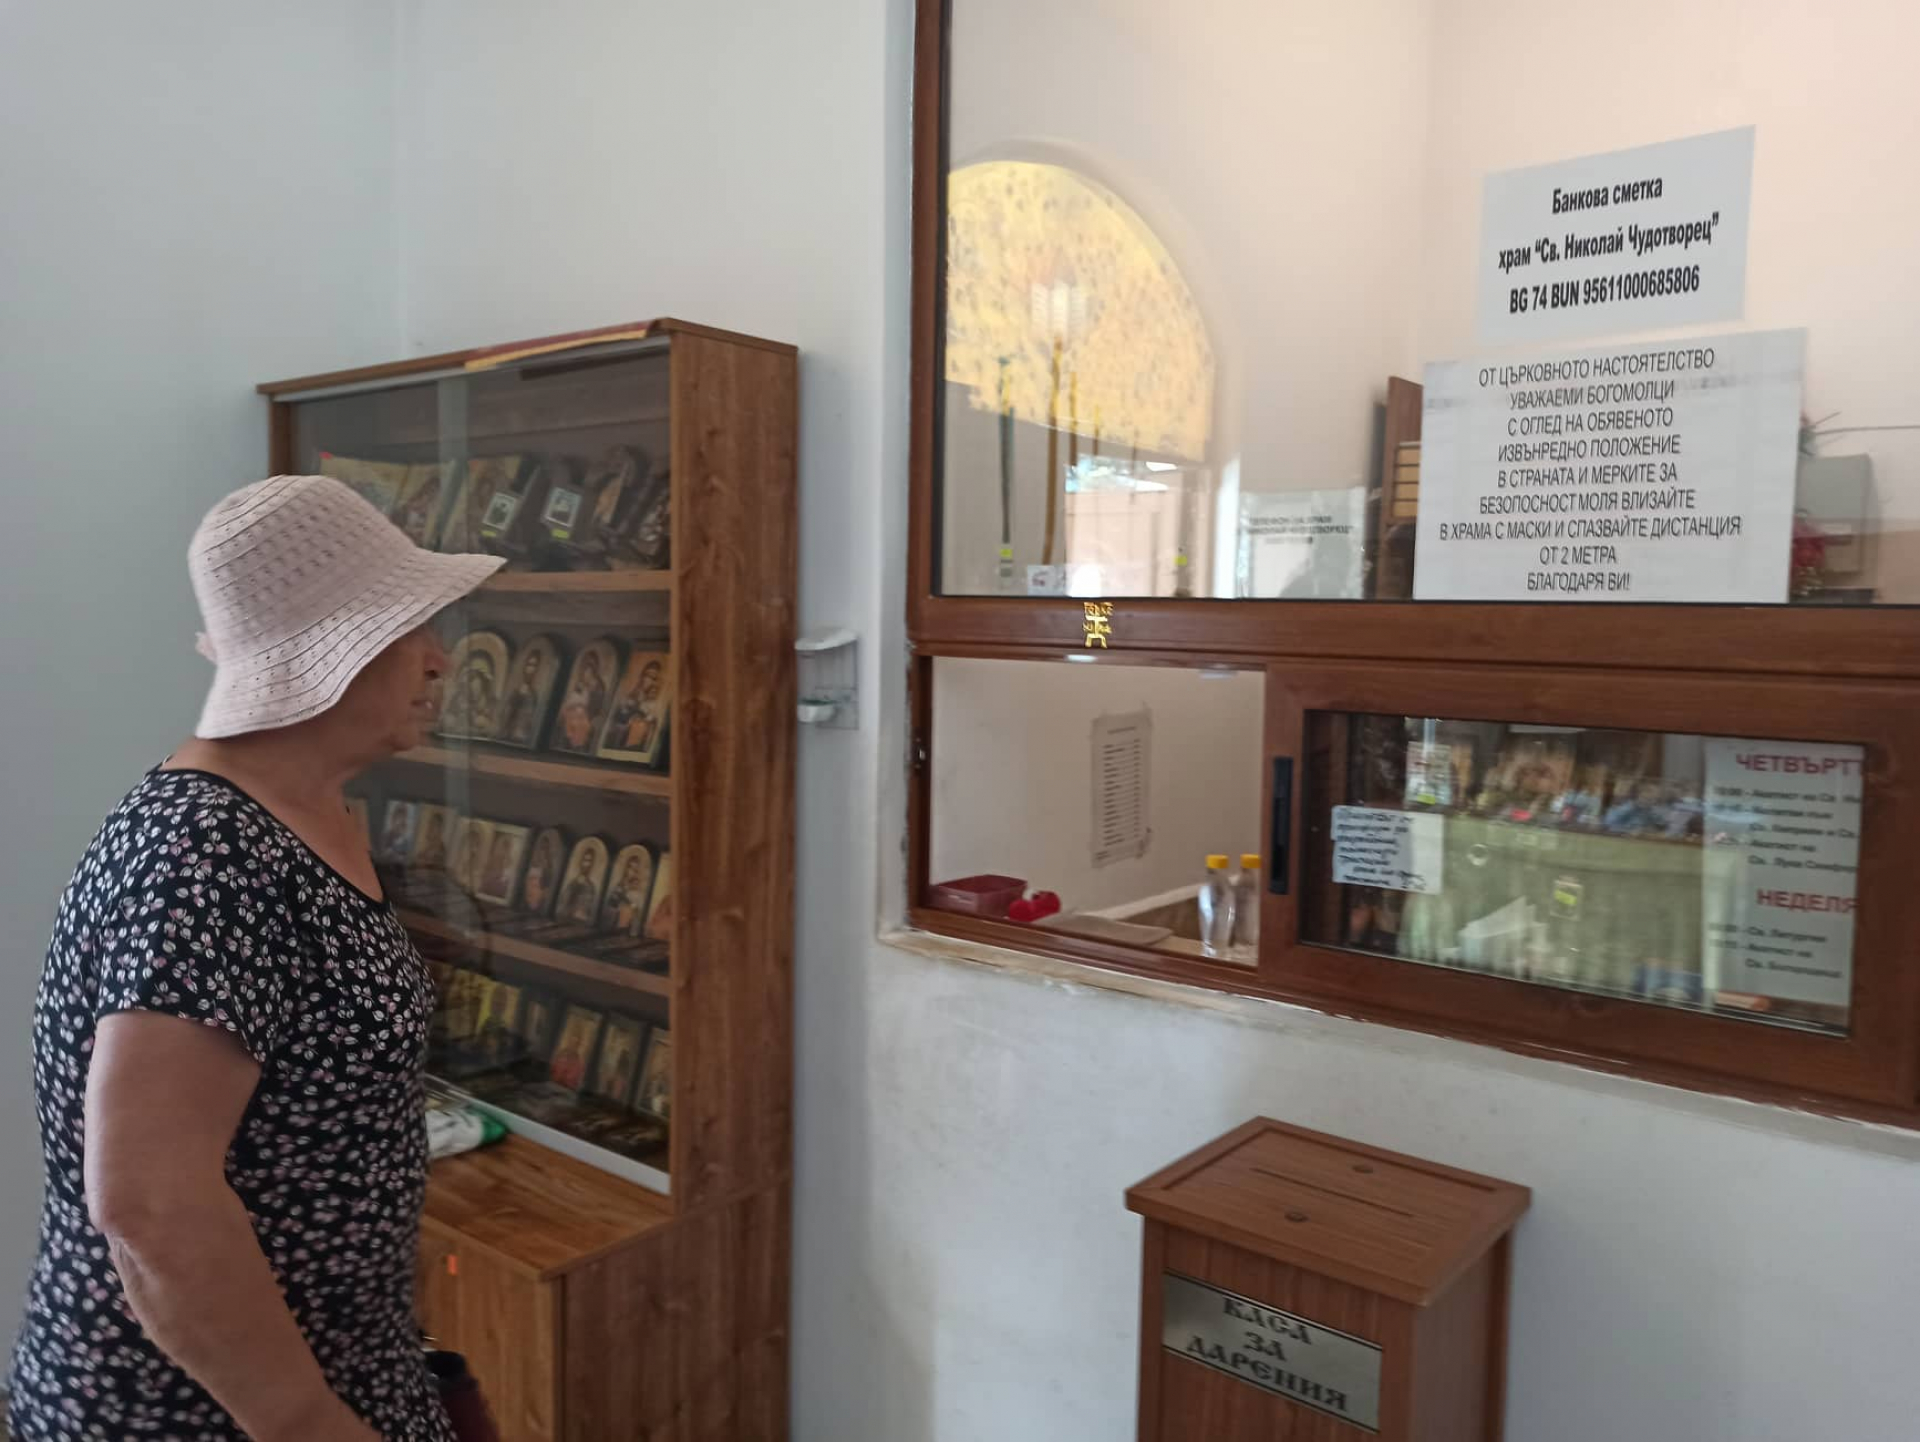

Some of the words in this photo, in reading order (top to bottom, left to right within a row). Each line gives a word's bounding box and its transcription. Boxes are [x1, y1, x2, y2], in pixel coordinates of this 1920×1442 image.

[1552, 187, 1609, 214] Банкова
[1613, 178, 1663, 204] сметка
[1498, 247, 1531, 274] храм
[1565, 226, 1623, 260] Николай
[1629, 211, 1719, 257] Чудотворец”
[1510, 288, 1528, 313] BG
[1532, 284, 1547, 310] 74
[1551, 279, 1579, 309] BUN
[1583, 265, 1699, 304] 95611000685806
[1479, 368, 1496, 387] ОТ
[1499, 359, 1590, 388] ЦЪРКОВНОТО
[1593, 348, 1715, 377] НАСТОЯТЕЛСТВО
[1510, 388, 1583, 410] УВАЖАЕМИ
[1587, 380, 1674, 405] БОГОМОЛЦИ
[1508, 417, 1517, 436] С
[1520, 415, 1561, 435] ОГЛЕД
[1565, 414, 1583, 433] НА
[1587, 407, 1673, 432] ОБЯВЕНОТО
[1498, 440, 1587, 462] ИЗВЪНРЕДНО
[1591, 434, 1681, 457] ПОЛОЖЕНИЕ
[1498, 470, 1506, 488] В
[1510, 467, 1575, 487] СТРАНАТА
[1578, 467, 1587, 485] И
[1591, 463, 1655, 484] МЕРКИТЕ
[1659, 462, 1677, 482] ЗА
[1480, 493, 1577, 514] БЕЗОПОСНОСТ
[1578, 491, 1617, 512] МОЛЯ
[1621, 487, 1696, 510] ВЛИЗАЙТЕ
[1440, 523, 1448, 540] В
[1450, 522, 1491, 540] ХРАМА
[1495, 522, 1505, 540] С
[1507, 520, 1551, 539] МАСКИ
[1555, 520, 1564, 538] И
[1567, 515, 1647, 538] СПАЗВАЙТЕ
[1650, 515, 1742, 540] ДИСТАНЦИЯ
[1539, 546, 1557, 565] ОТ
[1561, 547, 1569, 565] 2
[1572, 545, 1617, 565] МЕТРА
[1527, 572, 1603, 592] БЛАГОДАРЯ
[1607, 572, 1630, 591] ВИ!
[1736, 753, 1863, 776] ЧЕТВЪРТ
[1223, 1297, 1313, 1345] КАСА
[1244, 1331, 1287, 1361] ЗА
